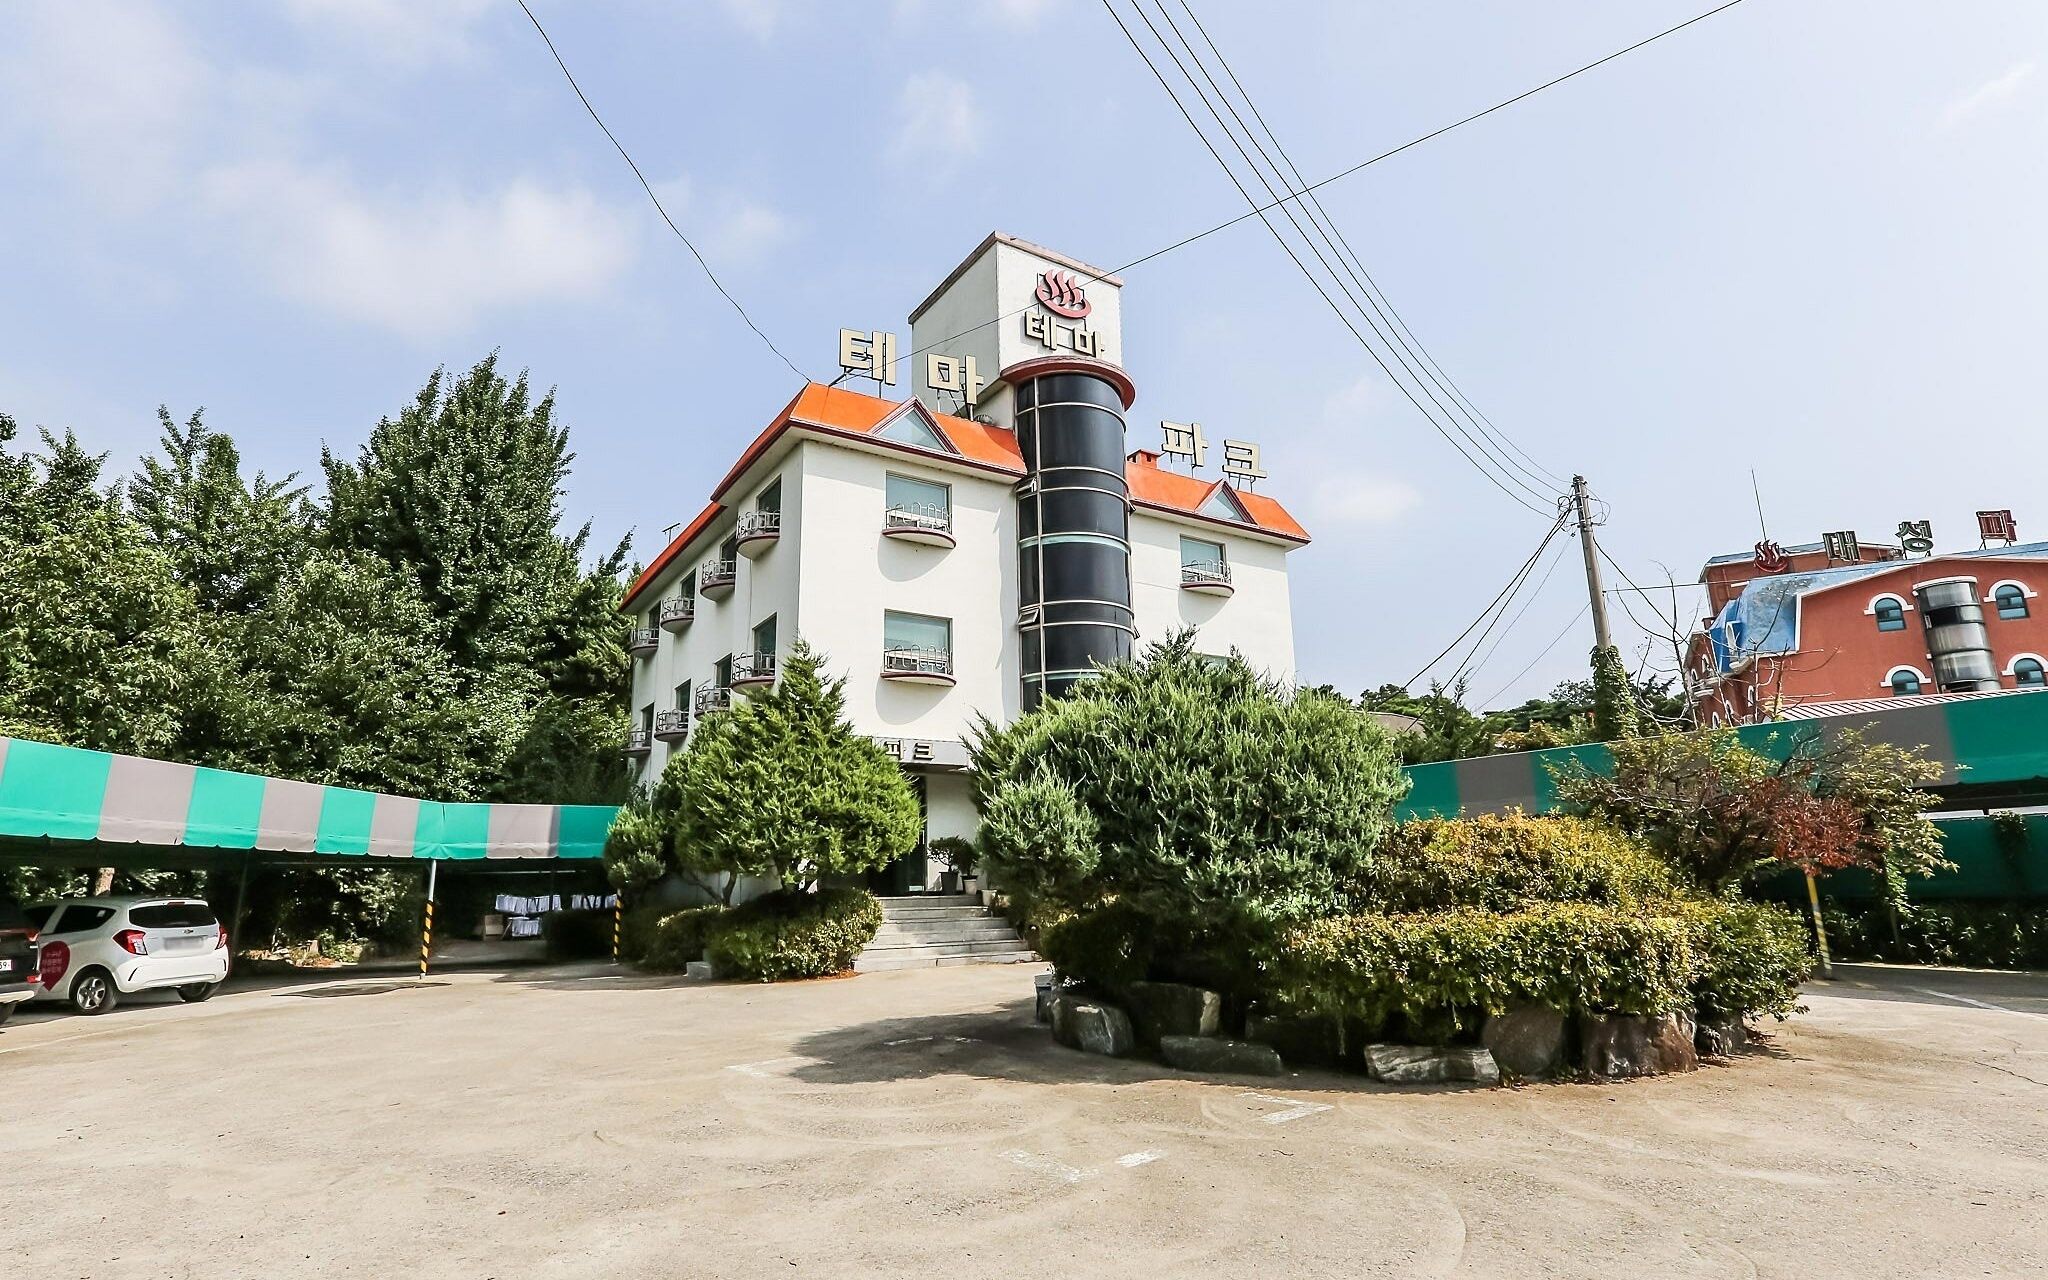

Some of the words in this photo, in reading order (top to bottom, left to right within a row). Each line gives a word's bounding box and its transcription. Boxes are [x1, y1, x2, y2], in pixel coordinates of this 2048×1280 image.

[1024, 310, 1105, 358] 테마
[839, 327, 984, 406] 테마
[1160, 420, 1268, 479] 파크
[884, 740, 935, 760] 파크
